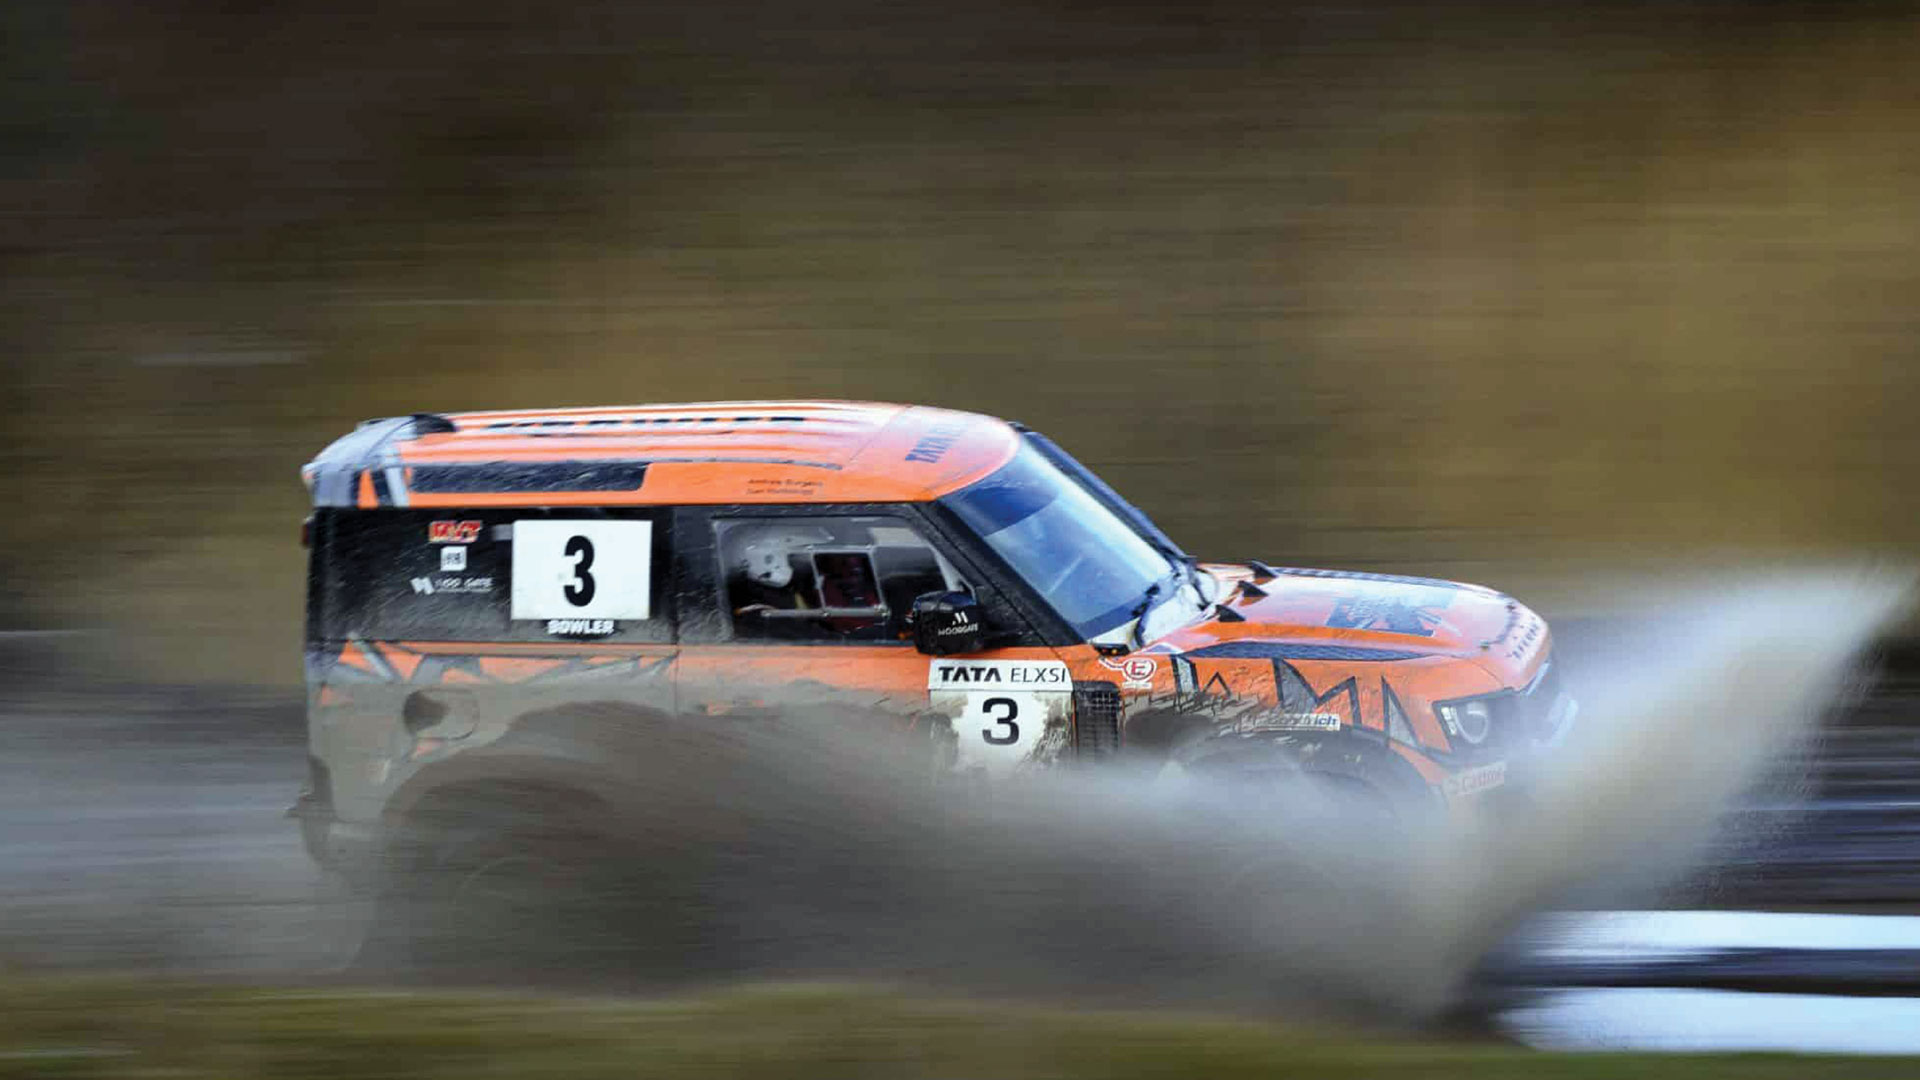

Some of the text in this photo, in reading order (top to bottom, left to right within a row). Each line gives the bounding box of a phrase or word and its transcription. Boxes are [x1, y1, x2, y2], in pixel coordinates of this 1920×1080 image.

[563, 535, 595, 607] 3
[548, 620, 615, 634] BOWLER
[938, 666, 1067, 683] TATA ELXSI
[981, 697, 1020, 746] 3
